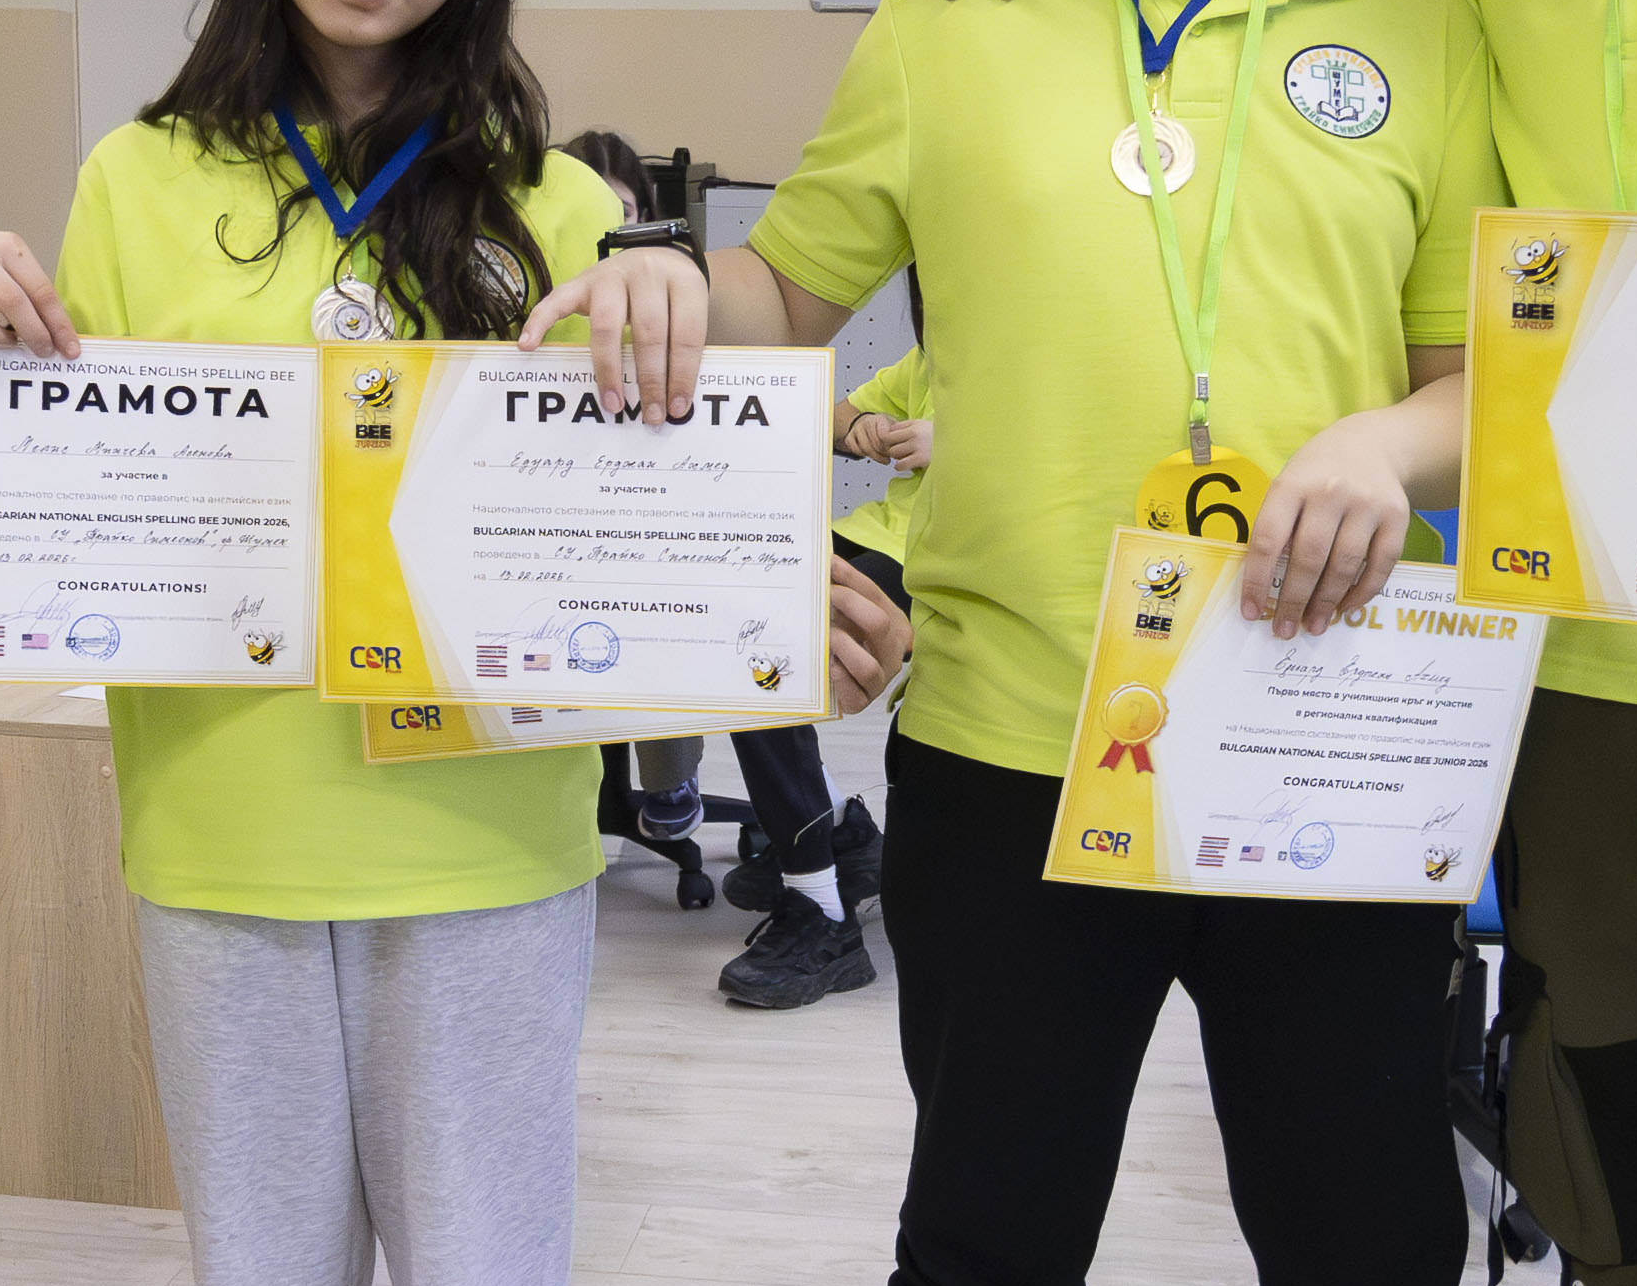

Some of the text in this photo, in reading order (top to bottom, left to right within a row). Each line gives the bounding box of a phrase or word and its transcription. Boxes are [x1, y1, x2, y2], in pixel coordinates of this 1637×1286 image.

[67, 364, 135, 376] NATIONAL
[139, 366, 198, 377] ENGLISH
[202, 367, 266, 380] SPELLING
[269, 369, 296, 381] BEE
[478, 370, 558, 382] BULGARIAN
[699, 375, 766, 387] SPELLING
[770, 376, 797, 387] BEE
[9, 379, 268, 417] ГРАМОТА
[1185, 473, 1249, 545] 6
[57, 581, 206, 592] CONGRATULATIONS!
[1394, 589, 1443, 603] ENGLISH
[558, 599, 707, 613] CONGRATULATIONS!
[1136, 614, 1172, 633] BEE
[1397, 608, 1518, 641] WINNER
[1219, 742, 1487, 767] BULGARIAN NATIONAL ENGLISH SPELLING BEE JUNIOR 2026
[1283, 776, 1403, 791] CONGRATULATIONS!
